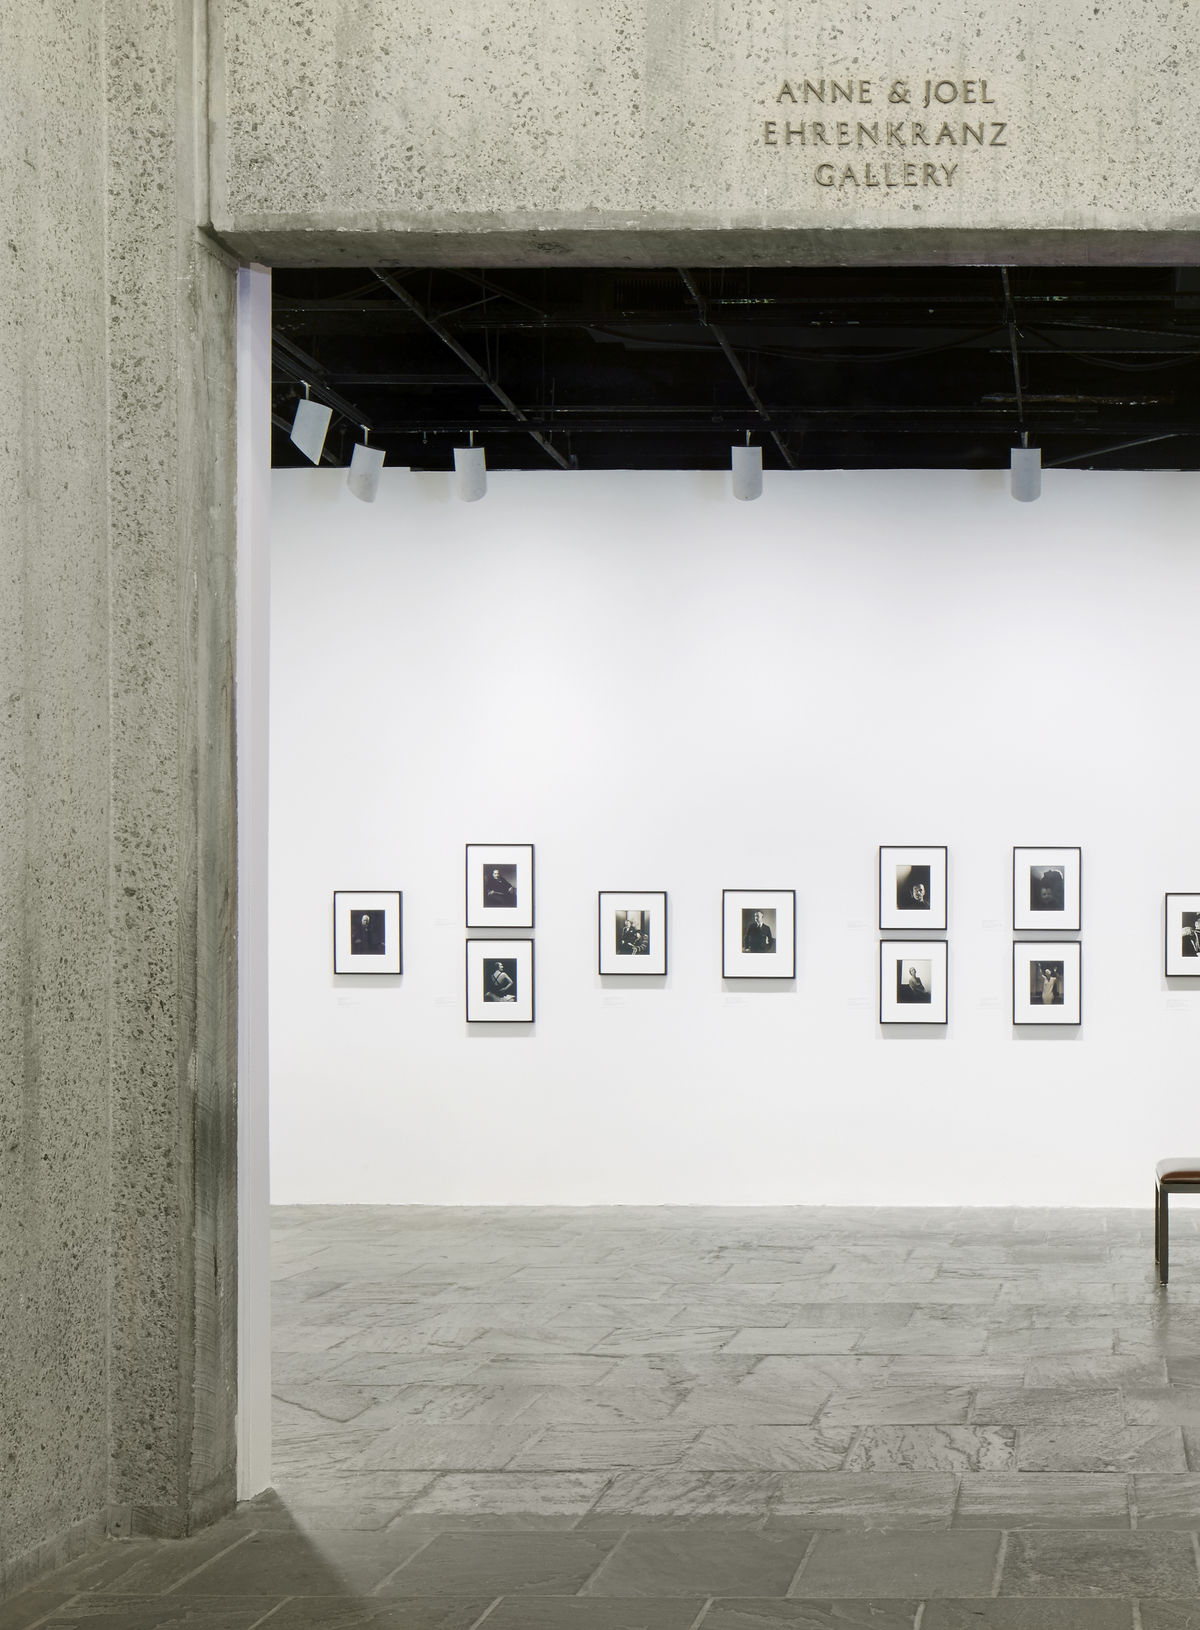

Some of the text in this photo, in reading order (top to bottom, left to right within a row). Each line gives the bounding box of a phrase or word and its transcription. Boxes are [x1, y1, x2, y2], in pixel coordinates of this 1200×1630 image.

[776, 80, 995, 108] ANNE & JOEL
[764, 121, 1007, 146] EHRENKRANZ
[814, 163, 958, 187] GALLERY
